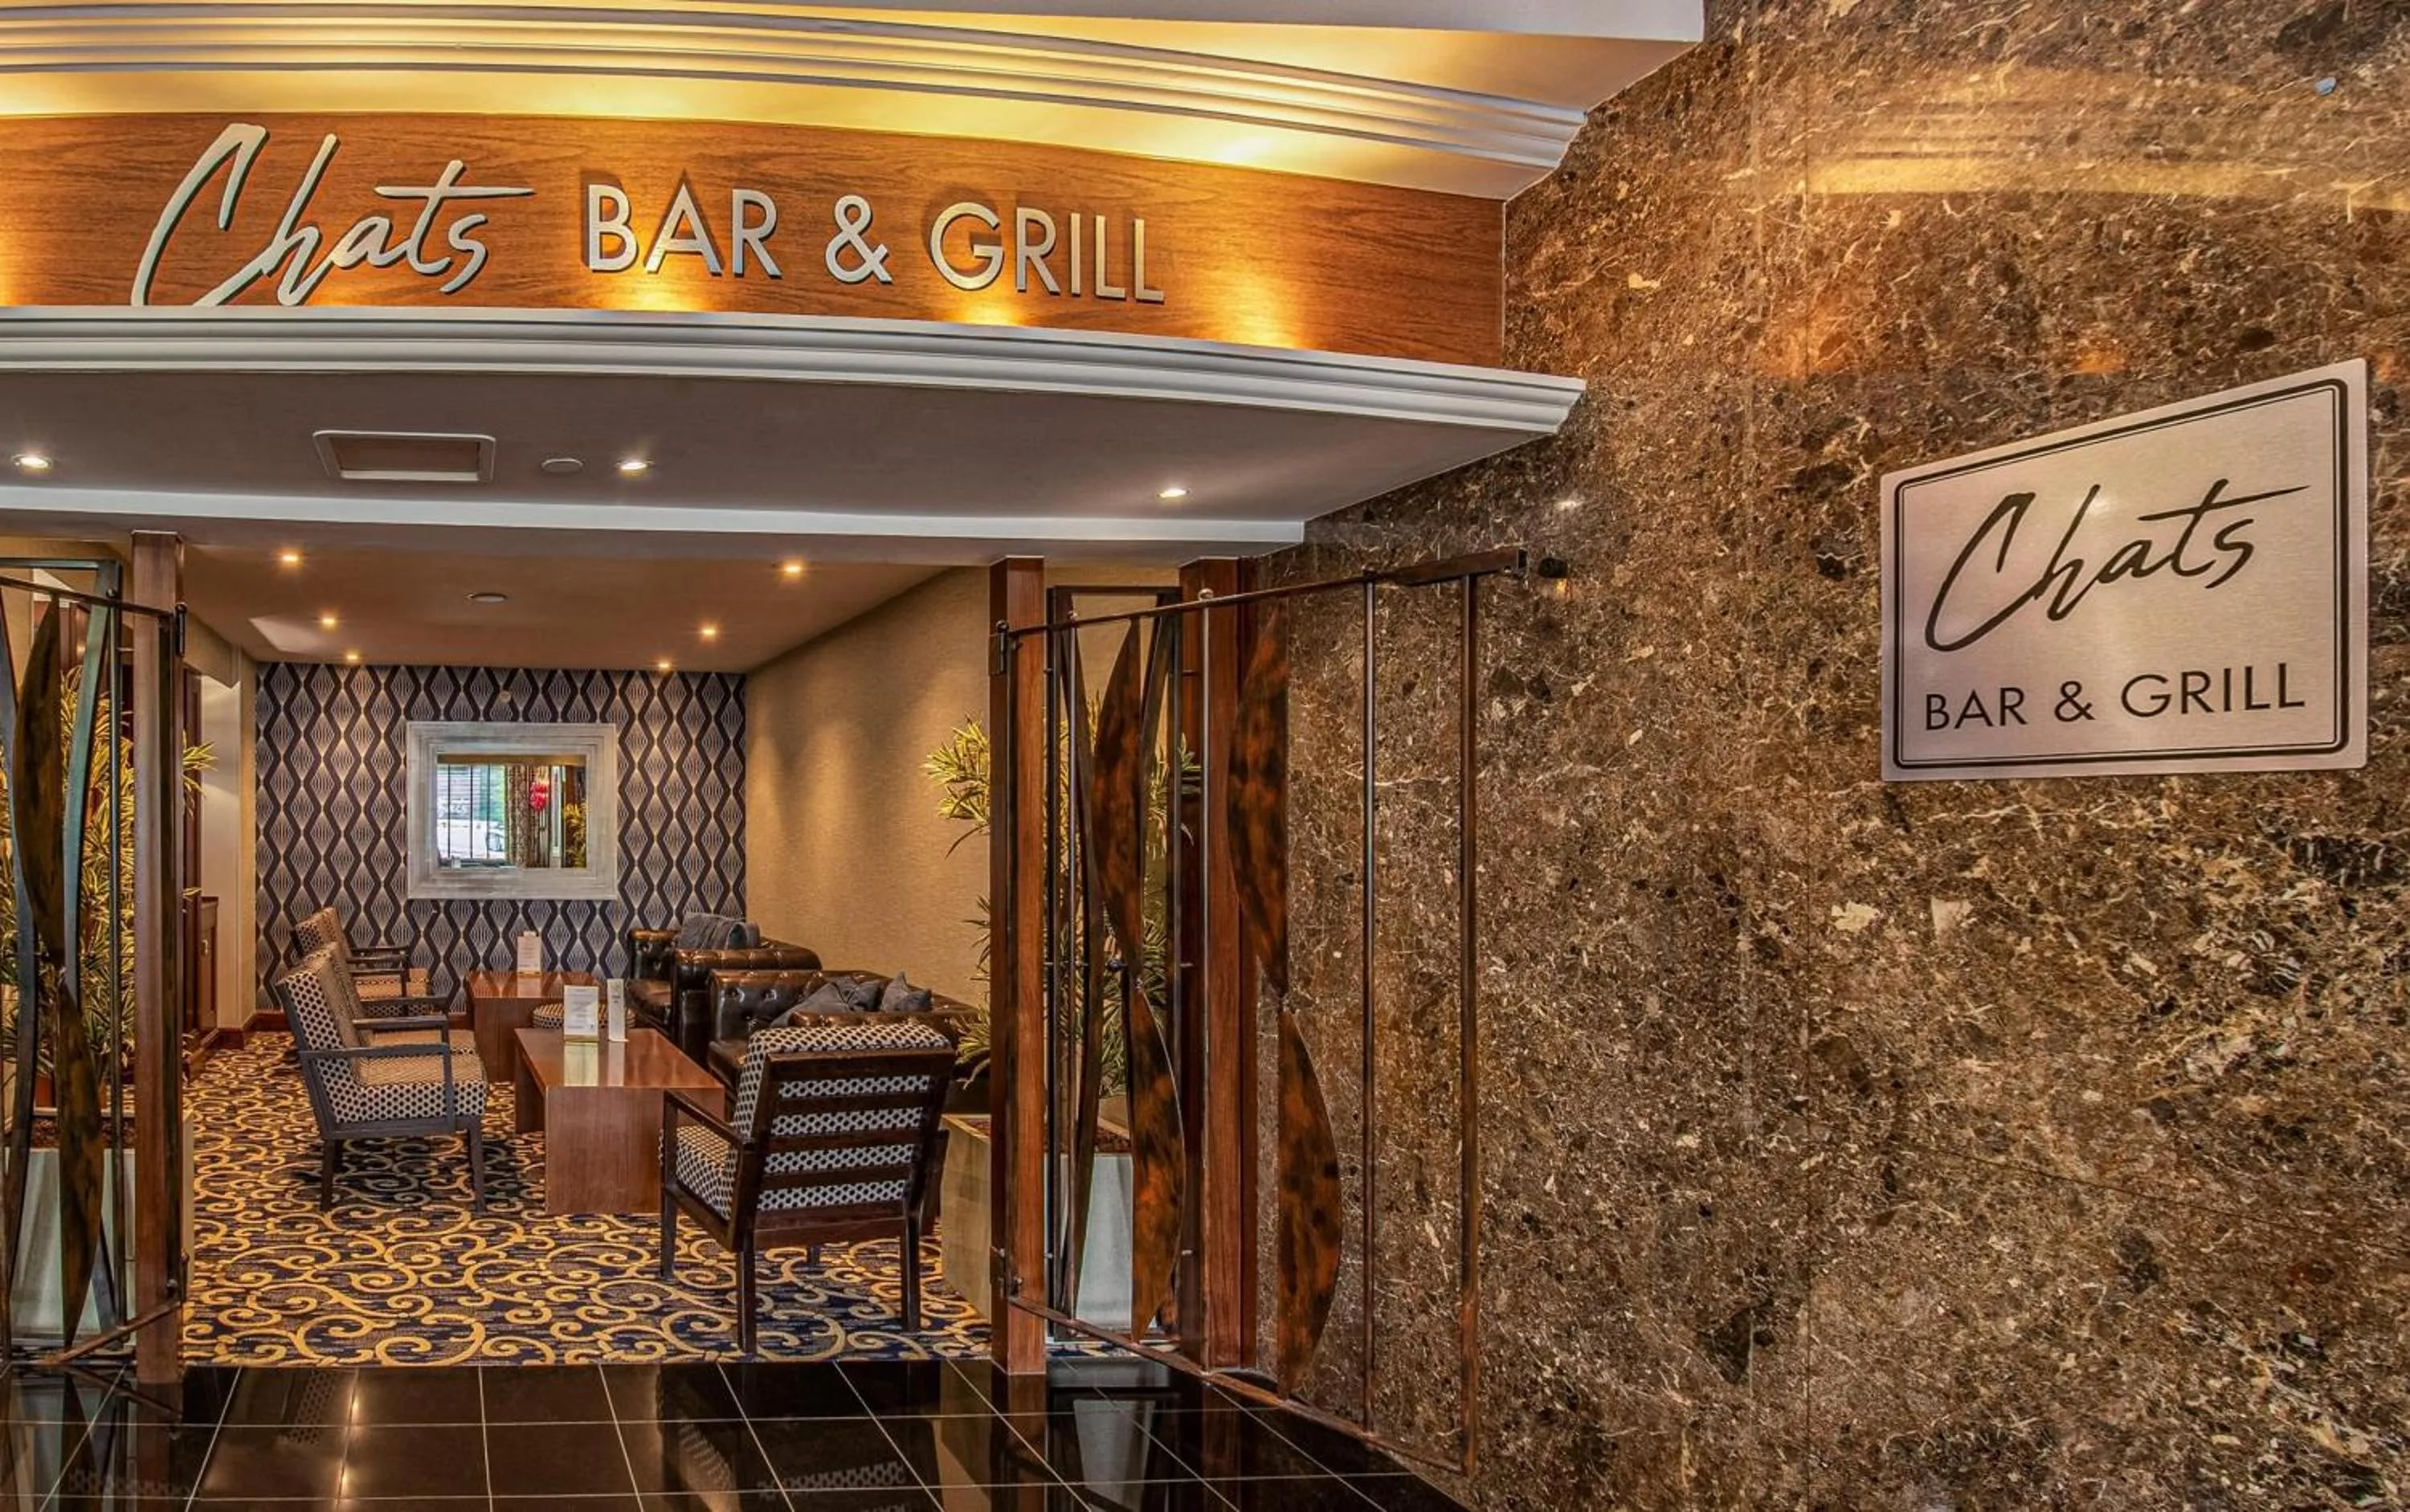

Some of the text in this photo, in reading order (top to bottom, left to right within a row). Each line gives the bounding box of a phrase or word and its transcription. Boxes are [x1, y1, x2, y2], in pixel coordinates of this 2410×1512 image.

[130, 122, 1165, 307] Chats BAR & GRILL
[1924, 478, 2311, 652] Chats
[1925, 662, 2306, 731] BAR & GRILL
